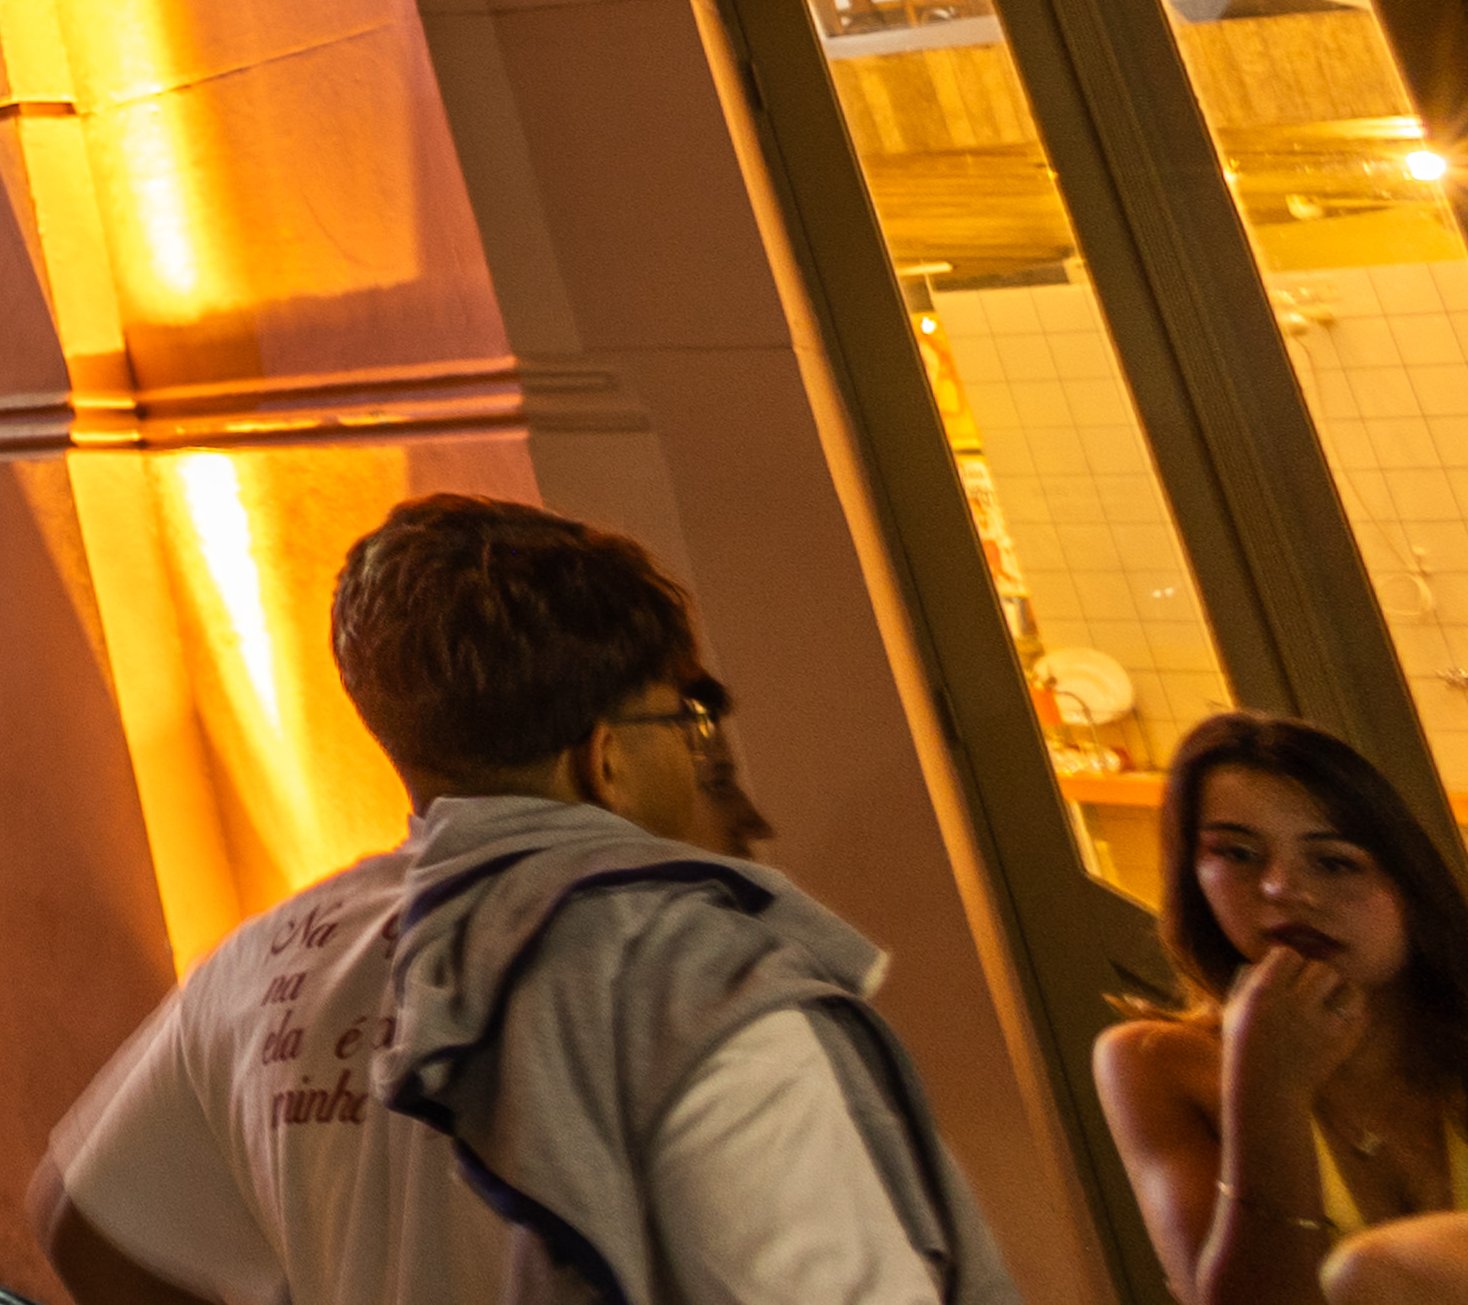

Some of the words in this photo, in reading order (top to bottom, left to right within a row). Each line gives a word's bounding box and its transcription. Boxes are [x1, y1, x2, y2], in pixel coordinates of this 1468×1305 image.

[261, 971, 307, 1007] na
[262, 1009, 303, 1065] ela
[335, 1016, 367, 1060] é
